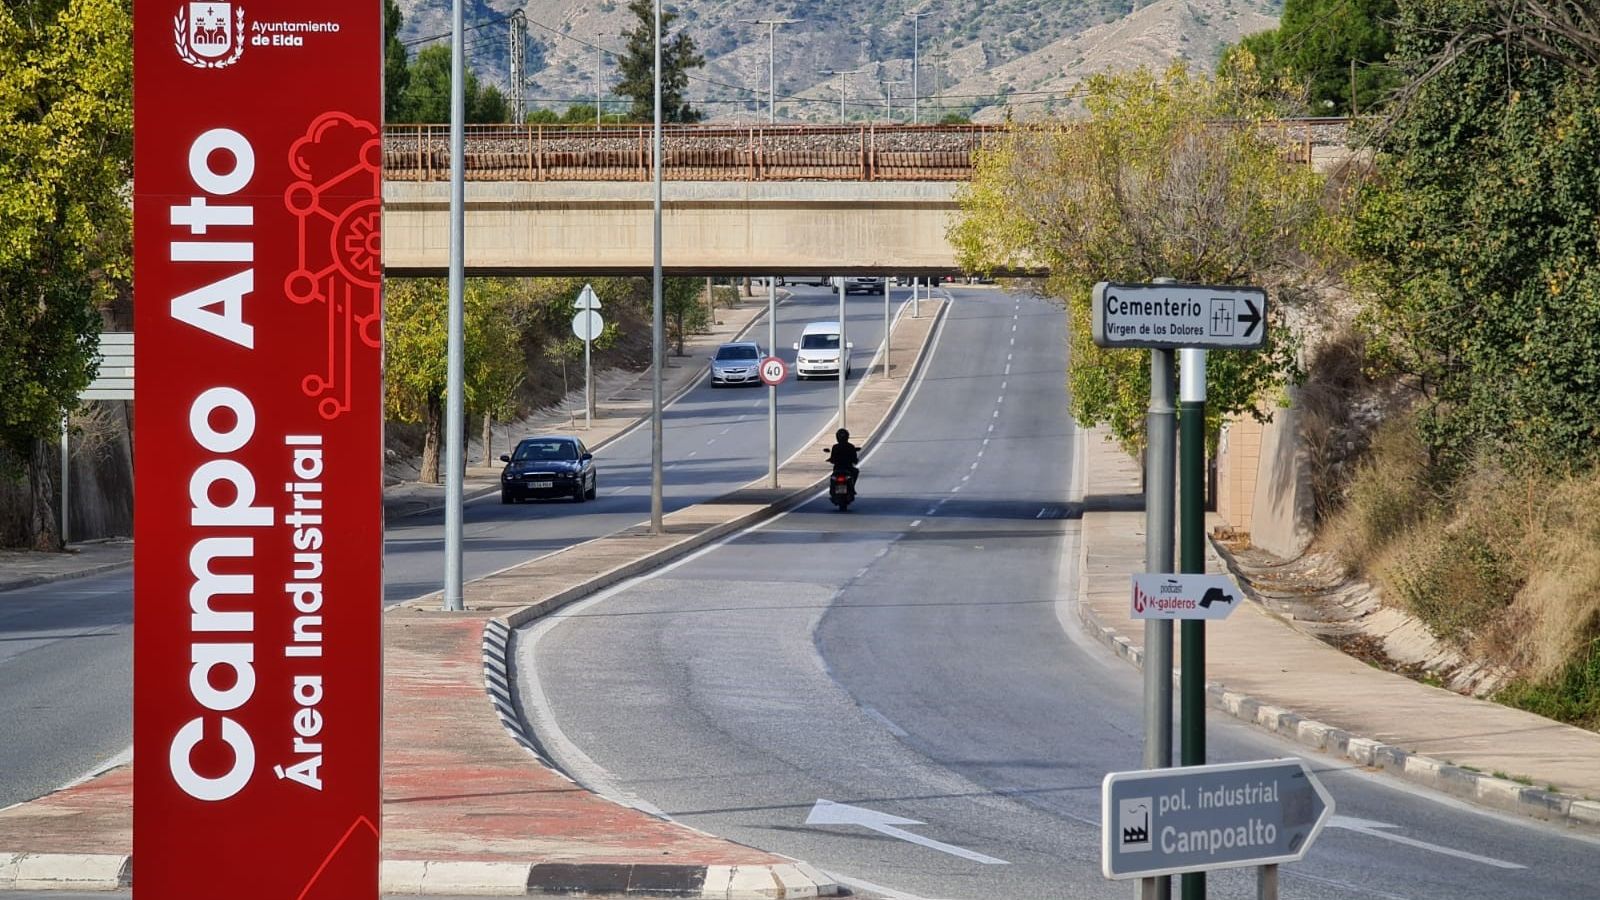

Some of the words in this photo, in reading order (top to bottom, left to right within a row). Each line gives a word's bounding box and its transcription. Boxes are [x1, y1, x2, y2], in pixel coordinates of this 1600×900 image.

[251, 20, 340, 33] Ayuntamiento
[251, 33, 270, 46] de
[272, 33, 303, 46] Elda
[170, 128, 255, 350] Alto
[1107, 295, 1202, 317] Cementerio
[1107, 323, 1136, 336] Virgen
[1139, 325, 1150, 334] de
[1153, 325, 1167, 335] los
[1170, 326, 1204, 335] Dolores
[767, 366, 781, 377] 40
[285, 434, 323, 657] Industrial
[170, 386, 274, 801] Campo
[1160, 584, 1182, 594] podcast
[1149, 596, 1196, 611] K-galderos
[274, 676, 323, 791] Área
[1159, 788, 1191, 815] pol.
[1198, 780, 1279, 809] industrial
[1160, 818, 1277, 855] Campoalto
